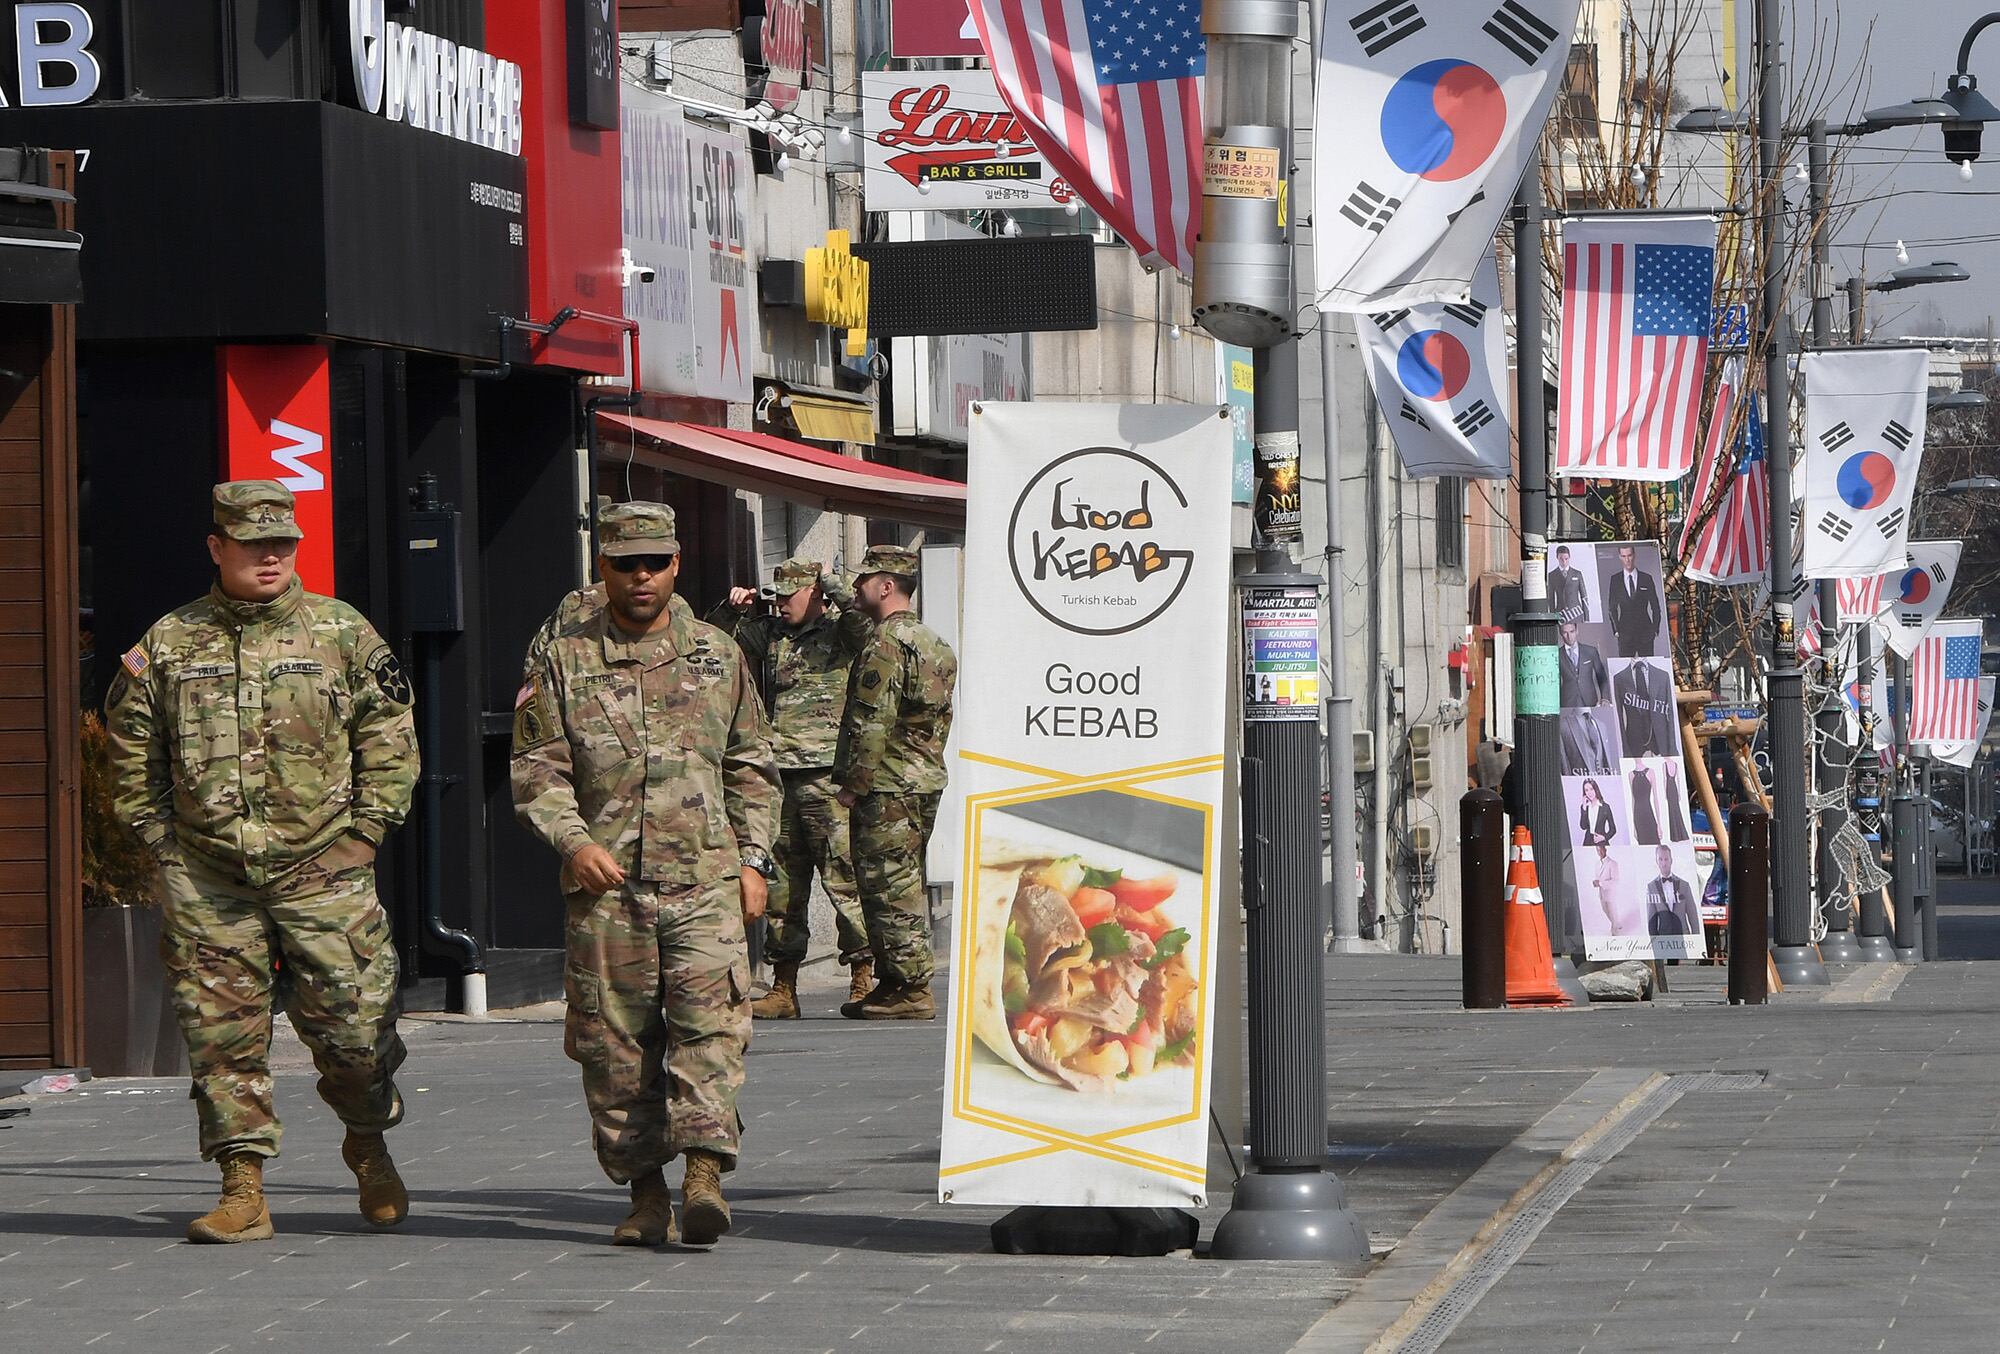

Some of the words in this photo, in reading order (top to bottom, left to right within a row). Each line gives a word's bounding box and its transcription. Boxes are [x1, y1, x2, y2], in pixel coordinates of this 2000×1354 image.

[0, 2, 100, 108] B
[930, 167, 960, 178] BAR
[967, 166, 977, 177] &
[984, 165, 1028, 177] GRILL
[1051, 477, 1153, 531] Good
[1032, 530, 1170, 583] KEBAB
[1061, 594, 1101, 606] Turkish
[1102, 594, 1138, 606] Kebab
[1253, 599, 1295, 608] MARTIAL
[1297, 598, 1316, 608] ARTS
[1264, 640, 1312, 649] JEETKUNEDO
[1267, 652, 1311, 660] MUAY-THAI
[1271, 663, 1308, 671] JIU-JITSU
[1045, 663, 1141, 695] Good
[1623, 692, 1650, 711] Slim
[1653, 699, 1671, 717] Fit
[1025, 705, 1159, 738] KEBAB
[1657, 939, 1696, 950] TAILOR
